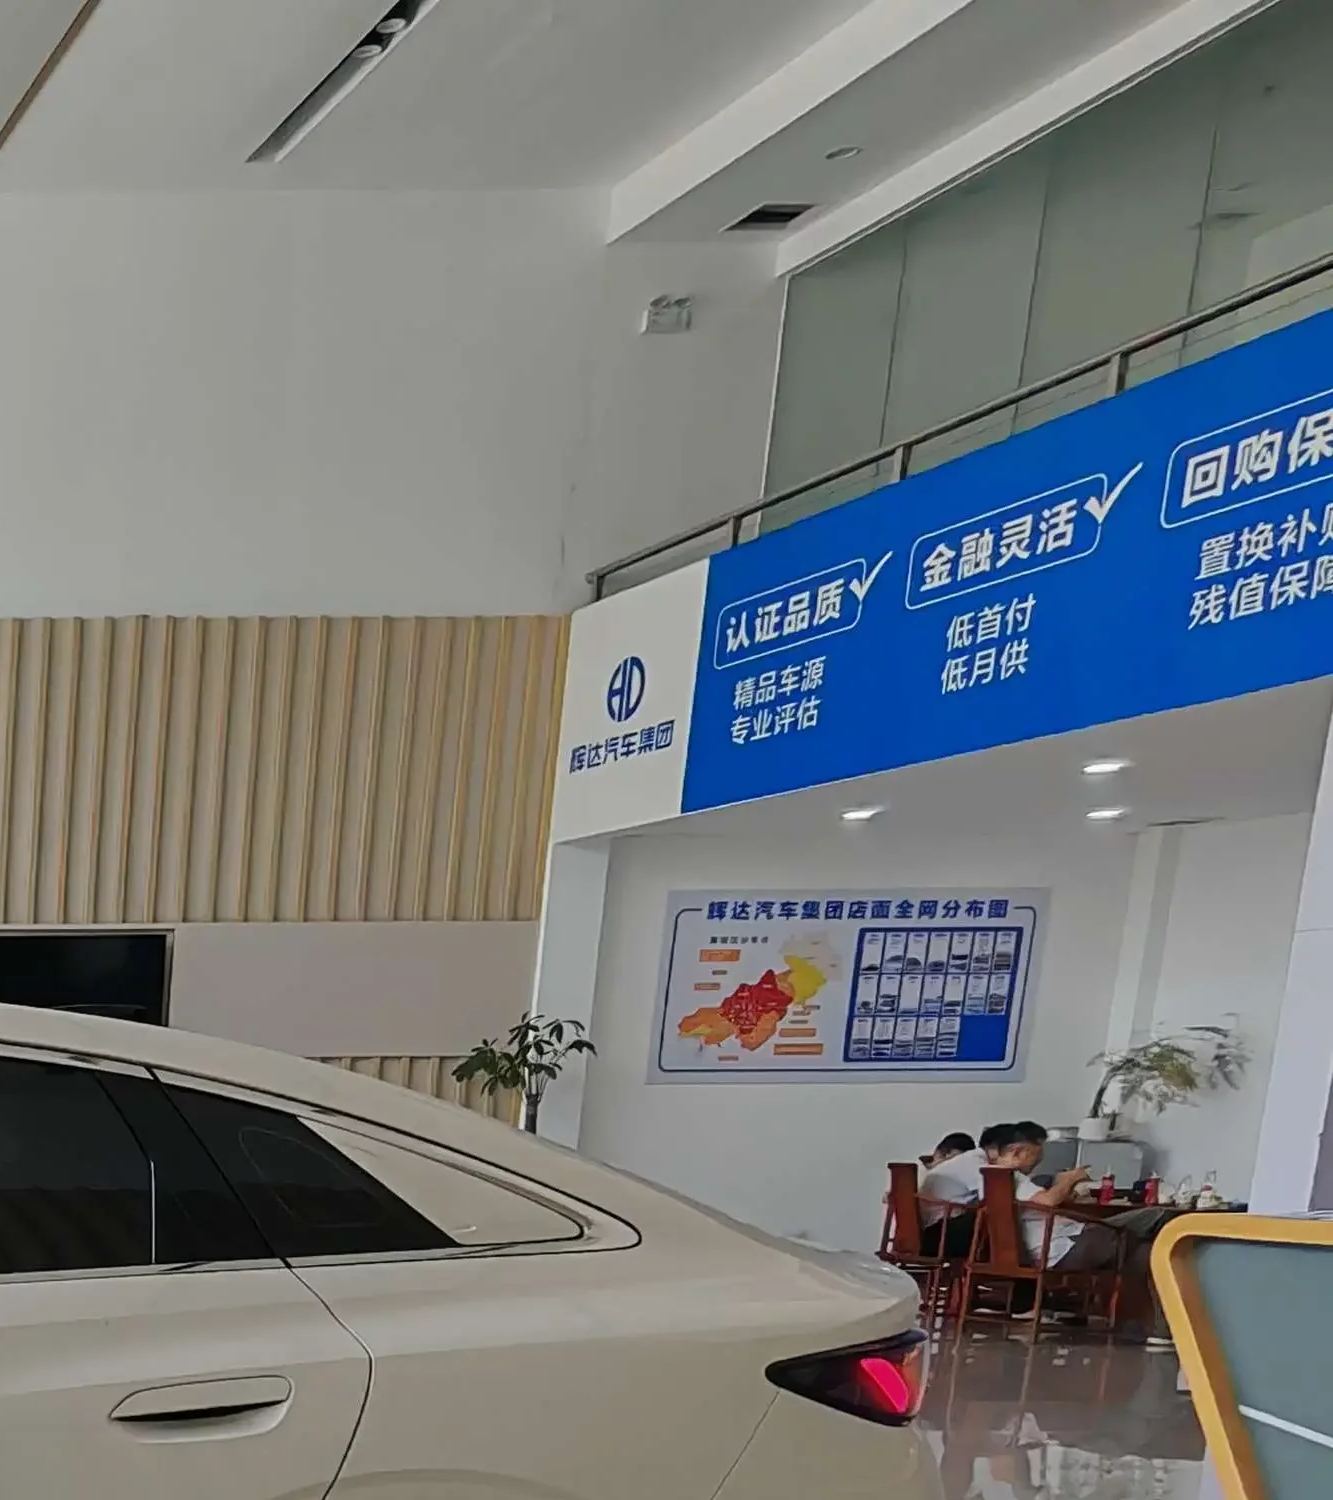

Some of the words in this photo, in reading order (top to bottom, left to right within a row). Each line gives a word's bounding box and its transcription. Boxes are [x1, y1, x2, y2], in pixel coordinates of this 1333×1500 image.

[920, 499, 1078, 592] 金融灵活
[726, 579, 845, 653] 认证品质
[946, 593, 1036, 652] 低首付
[733, 656, 827, 711] 精品车源
[940, 638, 1030, 695] 低月供
[569, 719, 675, 775] 辉达汽车集团
[729, 699, 821, 745] 专业评估
[706, 898, 1010, 921] 辉达汽车集团店面全网分布图
